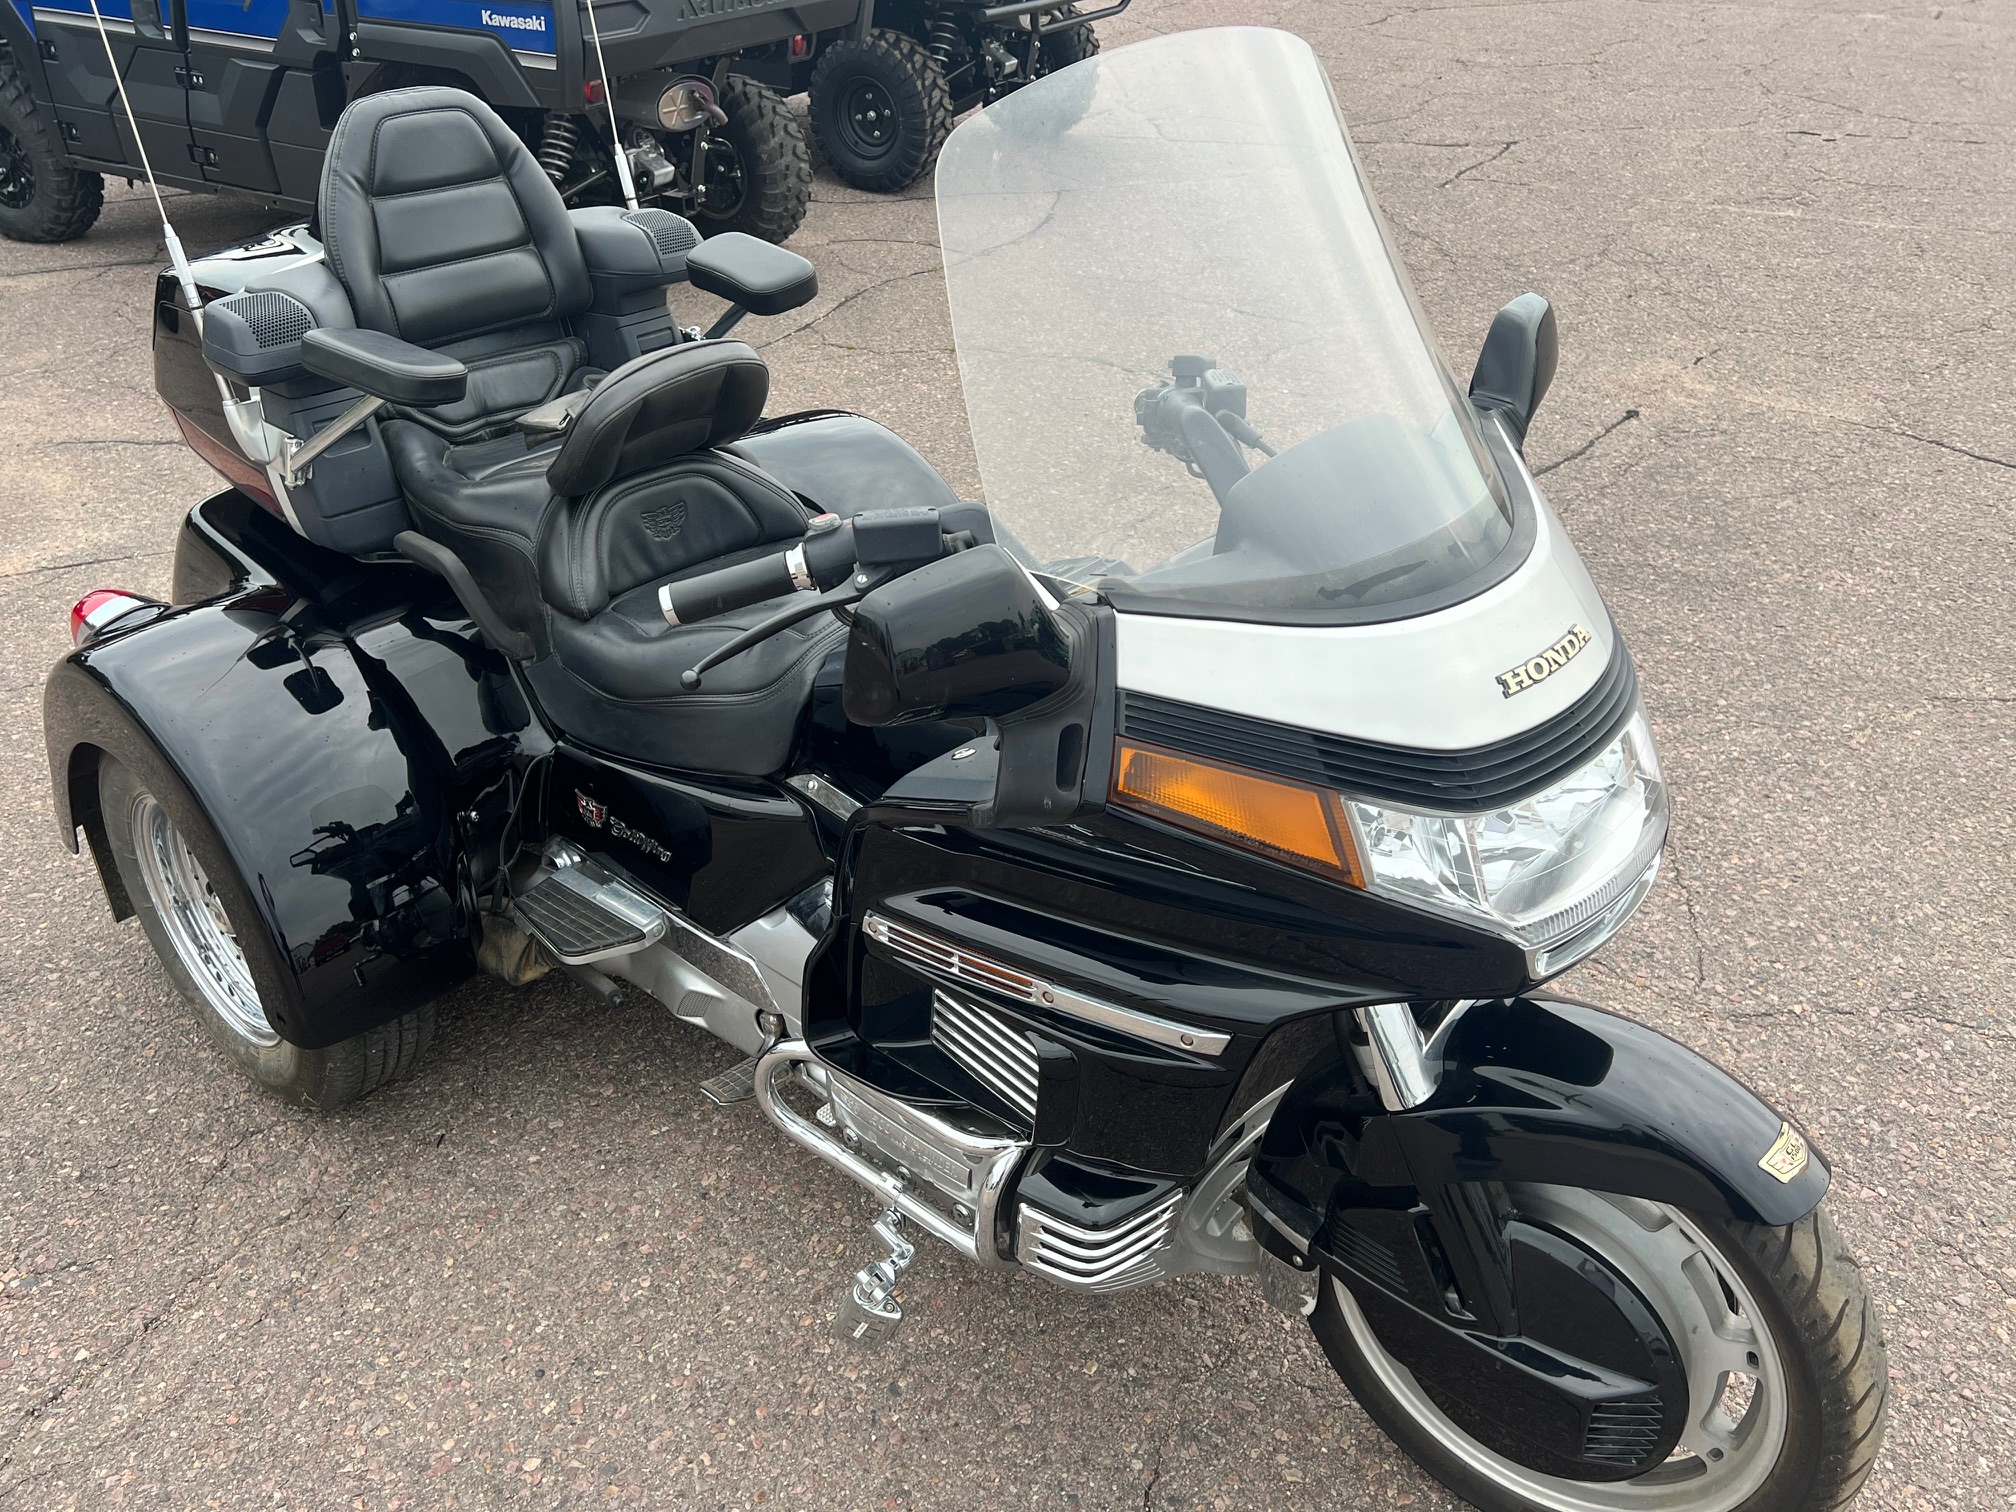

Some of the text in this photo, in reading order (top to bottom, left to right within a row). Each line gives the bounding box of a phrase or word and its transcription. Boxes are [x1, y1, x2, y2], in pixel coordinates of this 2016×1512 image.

[481, 9, 546, 31] Kawasaki
[1496, 623, 1592, 698] HONDA
[1785, 1142, 1797, 1156] GL
[1790, 1145, 1802, 1161] 1500
